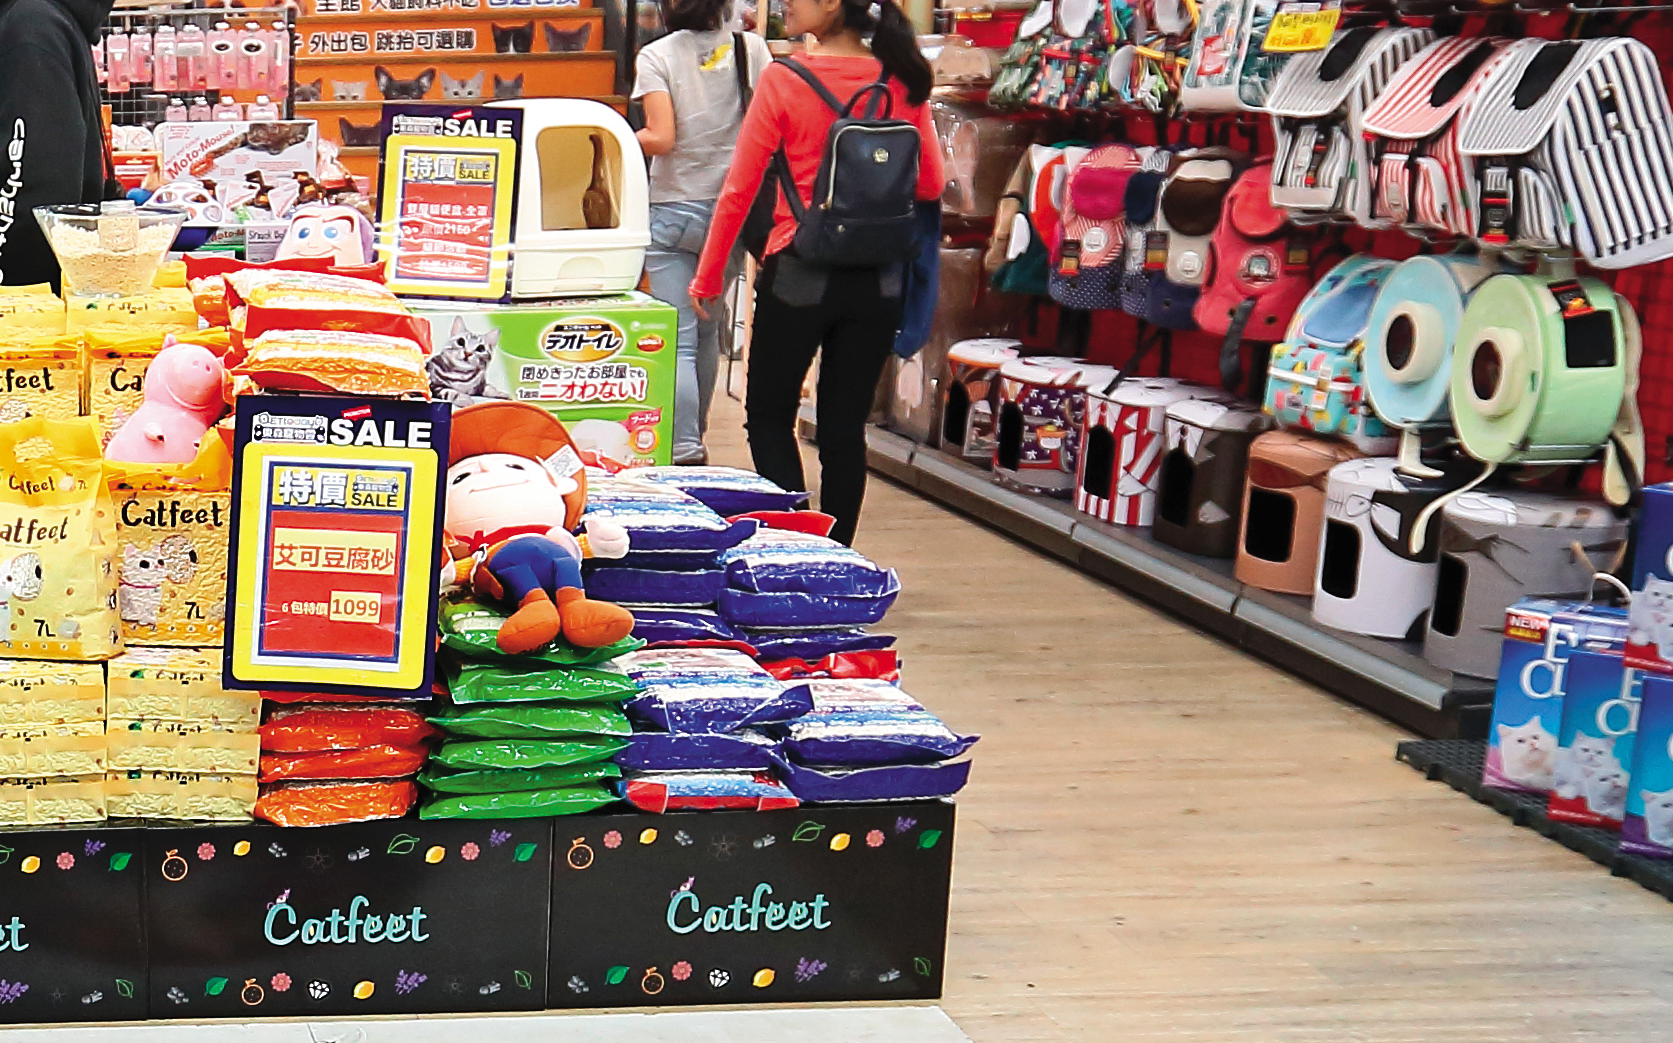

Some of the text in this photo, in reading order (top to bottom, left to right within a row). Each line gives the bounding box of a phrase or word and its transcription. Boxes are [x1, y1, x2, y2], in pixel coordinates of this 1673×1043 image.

[310, 33, 368, 53] 外出包
[444, 119, 513, 139] SALE
[459, 170, 489, 180] SALE
[546, 334, 622, 352] デオトイレ
[330, 419, 432, 448] SALE
[279, 470, 348, 508] 特價
[351, 493, 398, 508] SALE
[122, 500, 223, 528] Catfeet
[275, 543, 394, 571] 艾可豆腐砂
[185, 602, 205, 619] 7L
[331, 597, 379, 617] 1099
[34, 619, 56, 637] 7L
[1510, 615, 1540, 628] NEW
[667, 883, 832, 935] Catfeet
[264, 895, 430, 946] Catfeet
